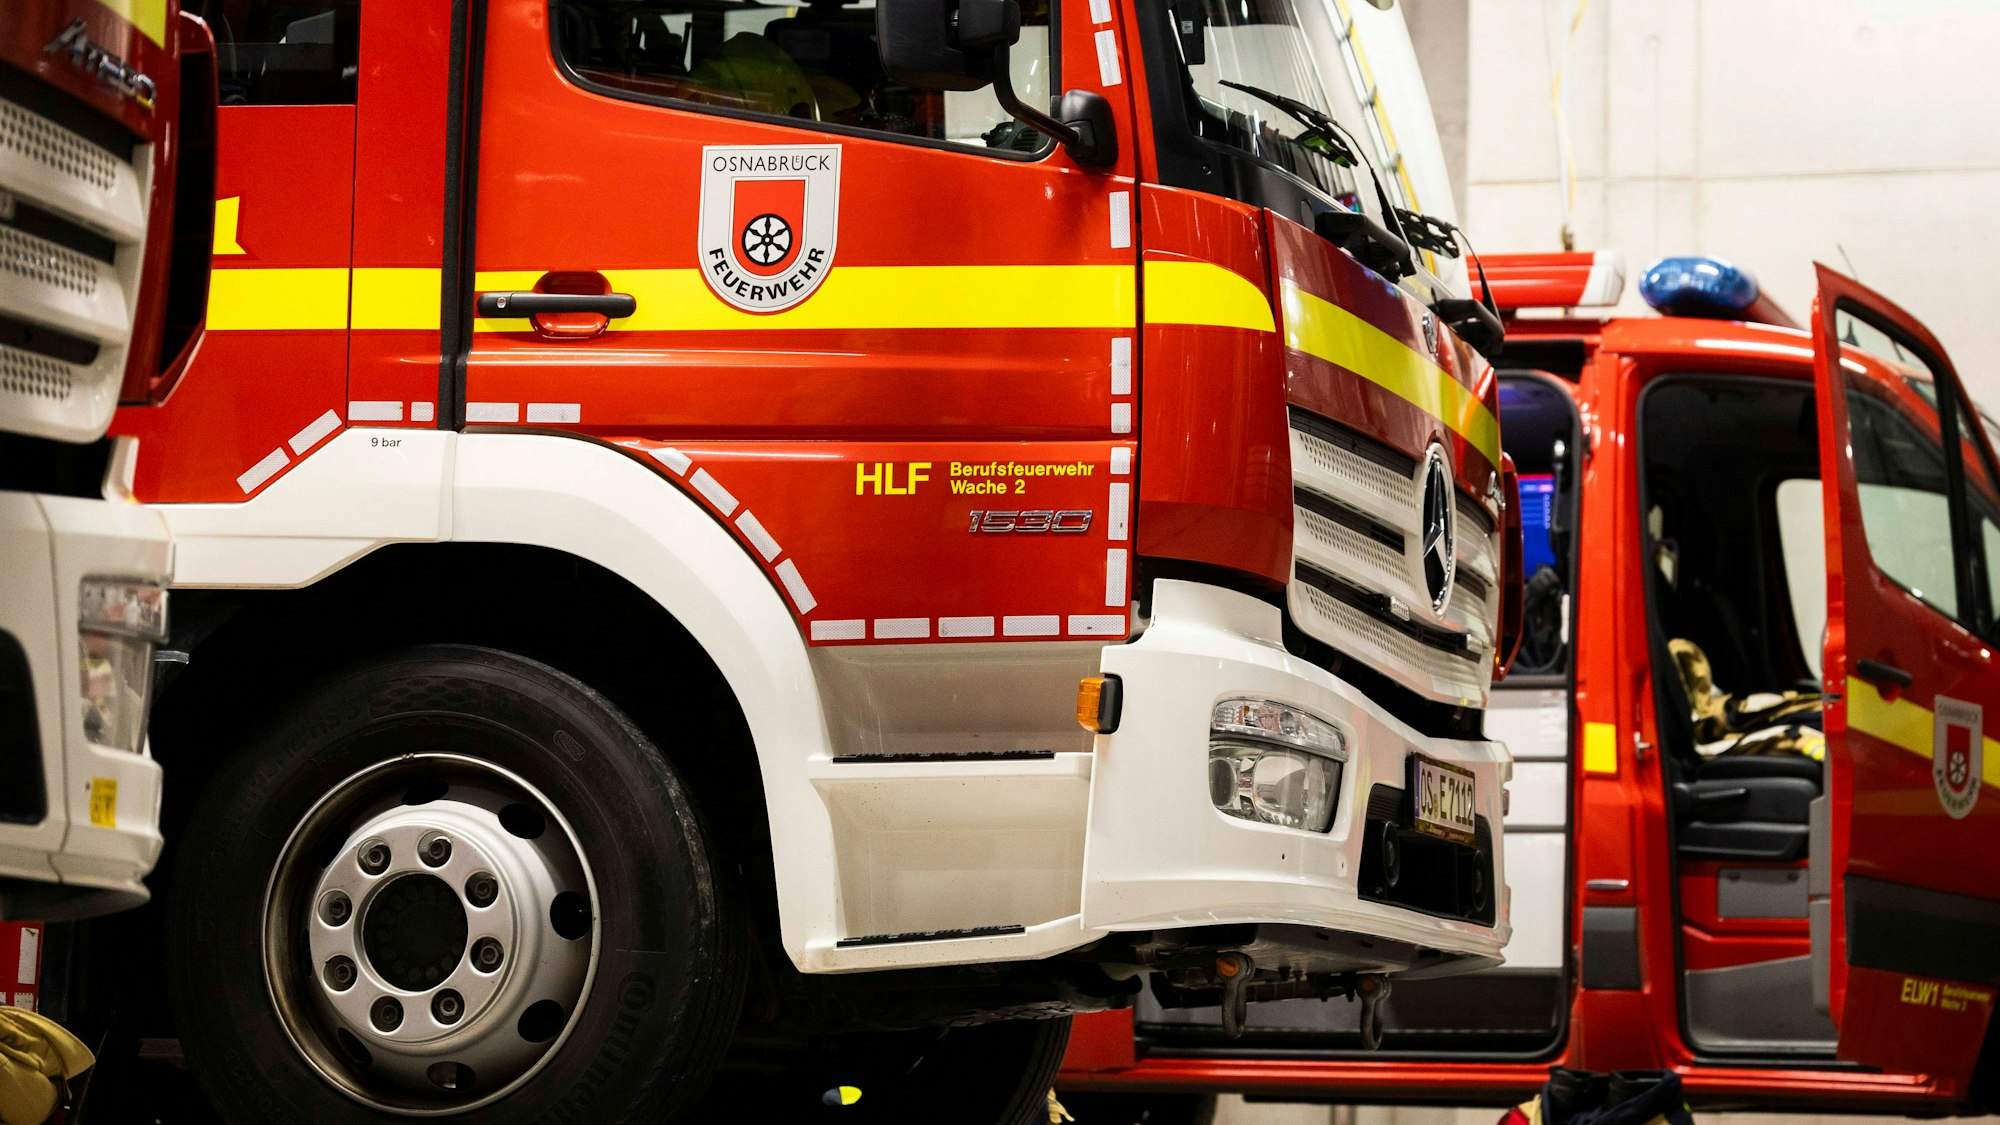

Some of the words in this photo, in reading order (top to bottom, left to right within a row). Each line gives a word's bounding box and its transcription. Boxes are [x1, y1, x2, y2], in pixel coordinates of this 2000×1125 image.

[712, 154, 831, 173] OSNABRÜCK
[708, 247, 825, 302] FEUERWEHR
[370, 436, 379, 448] 9
[382, 436, 402, 448] bar
[855, 461, 932, 496] HLF
[949, 461, 1095, 477] Berufsfeuerwehr
[949, 479, 1008, 495] Wache
[1014, 478, 1026, 494] 2
[968, 509, 1094, 534] 1530
[1420, 767, 1434, 816] OS
